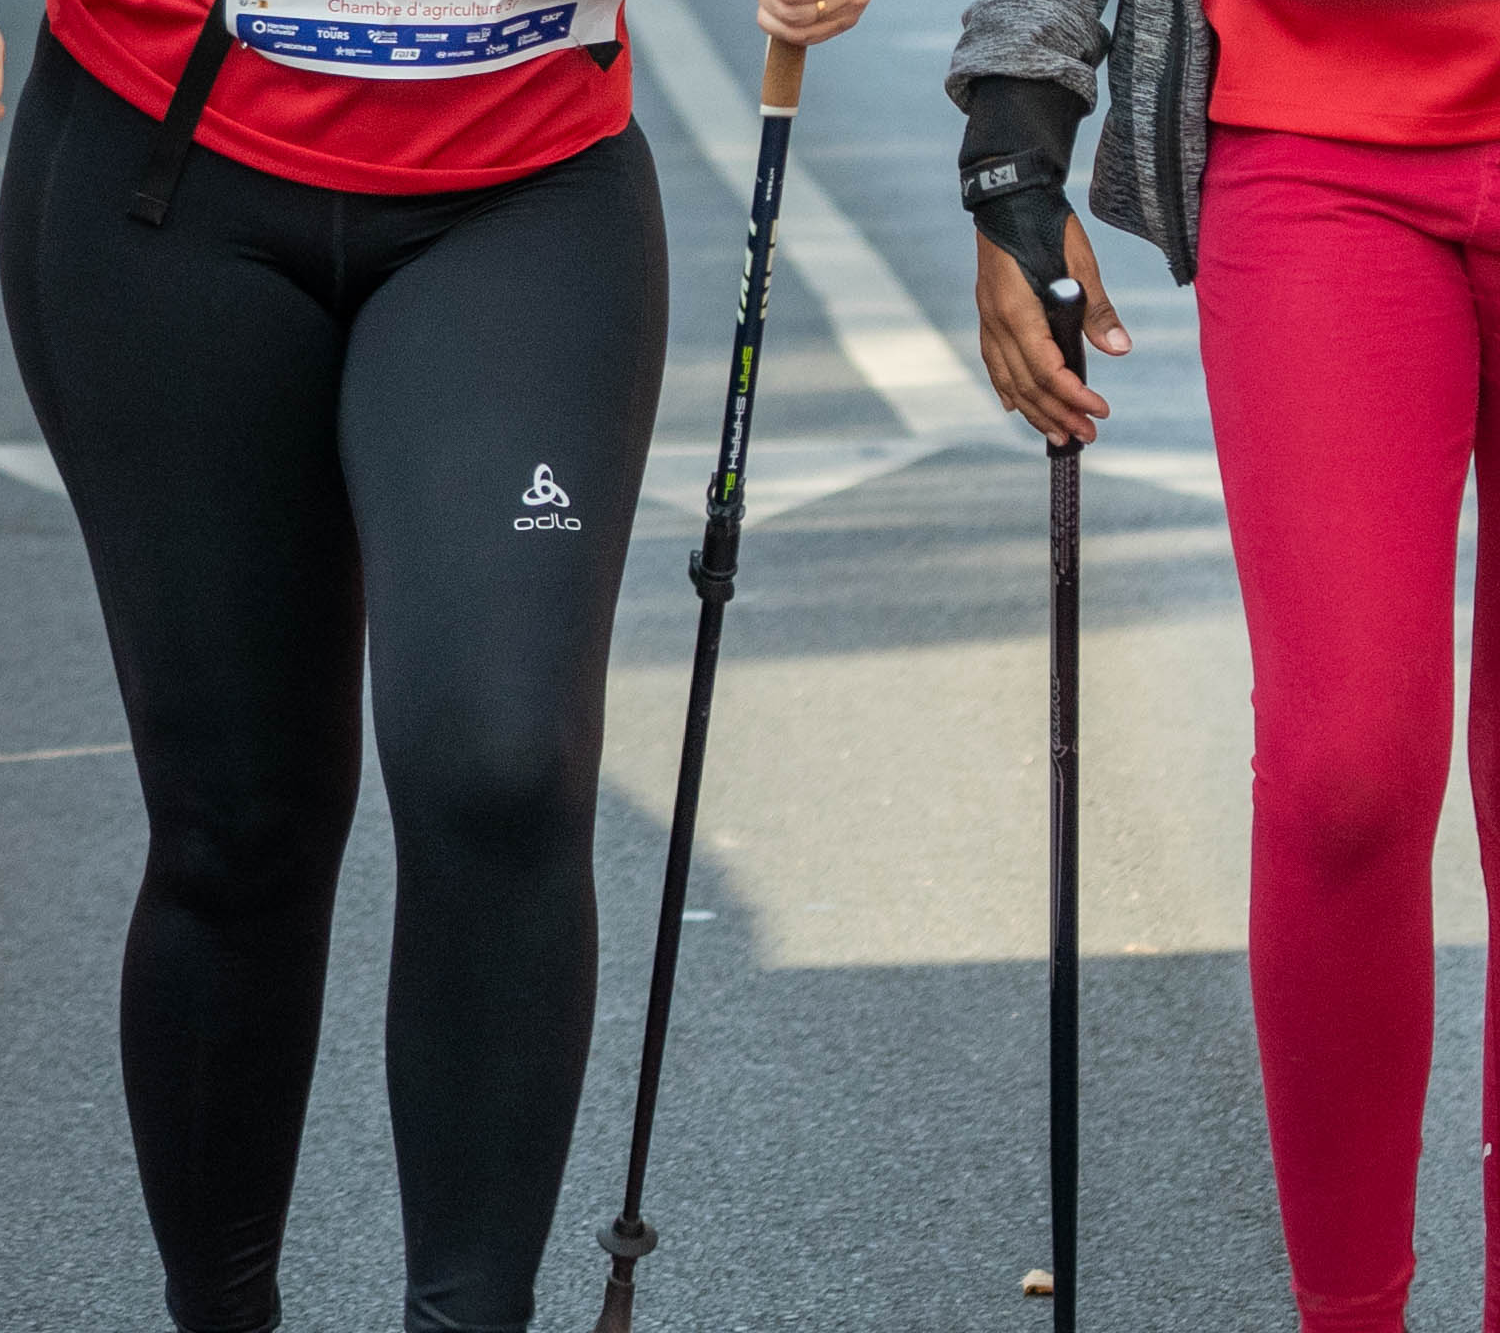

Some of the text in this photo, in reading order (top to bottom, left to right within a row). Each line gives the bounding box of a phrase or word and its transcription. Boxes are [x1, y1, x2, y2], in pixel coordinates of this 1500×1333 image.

[406, 1, 502, 20] d'agriculture
[316, 29, 350, 41] TOURS
[728, 395, 747, 469] SHARK
[513, 512, 582, 531] odlo
